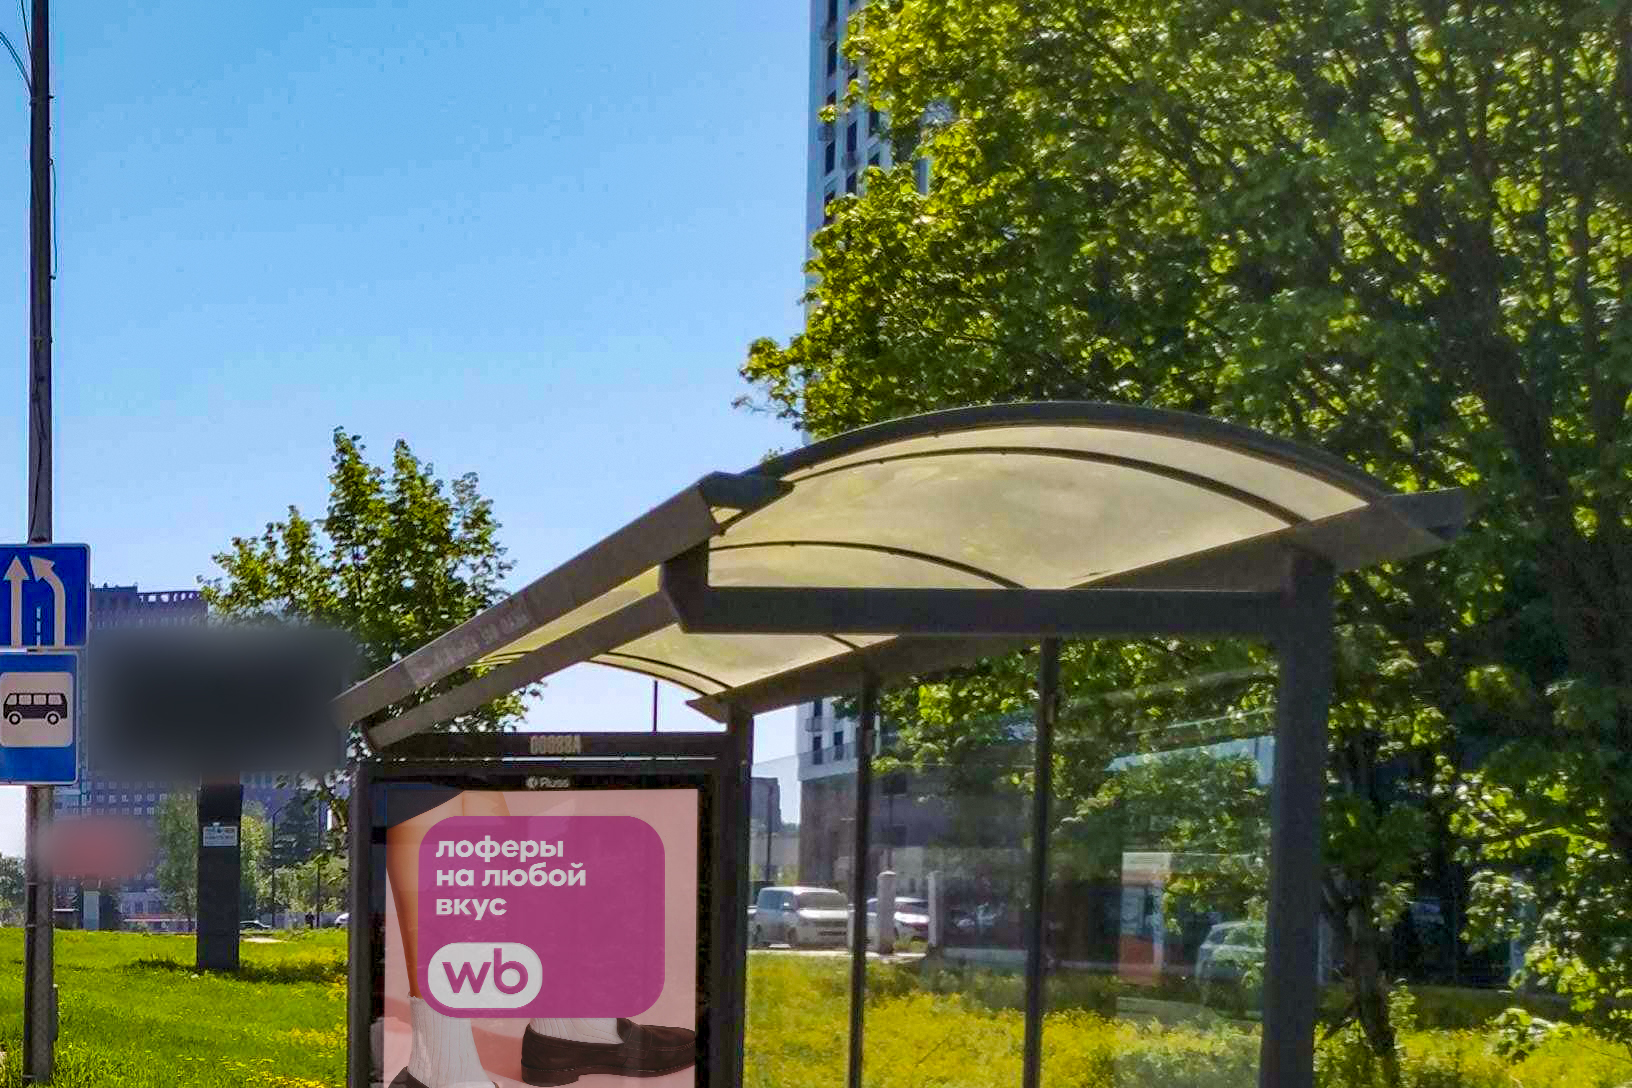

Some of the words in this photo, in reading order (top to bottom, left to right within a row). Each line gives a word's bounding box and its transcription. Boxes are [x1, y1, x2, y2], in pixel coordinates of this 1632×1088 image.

[435, 835, 564, 862] лоферы
[436, 869, 474, 887] на
[481, 862, 586, 887] любой
[436, 897, 507, 920] вкус
[442, 948, 528, 995] wb
